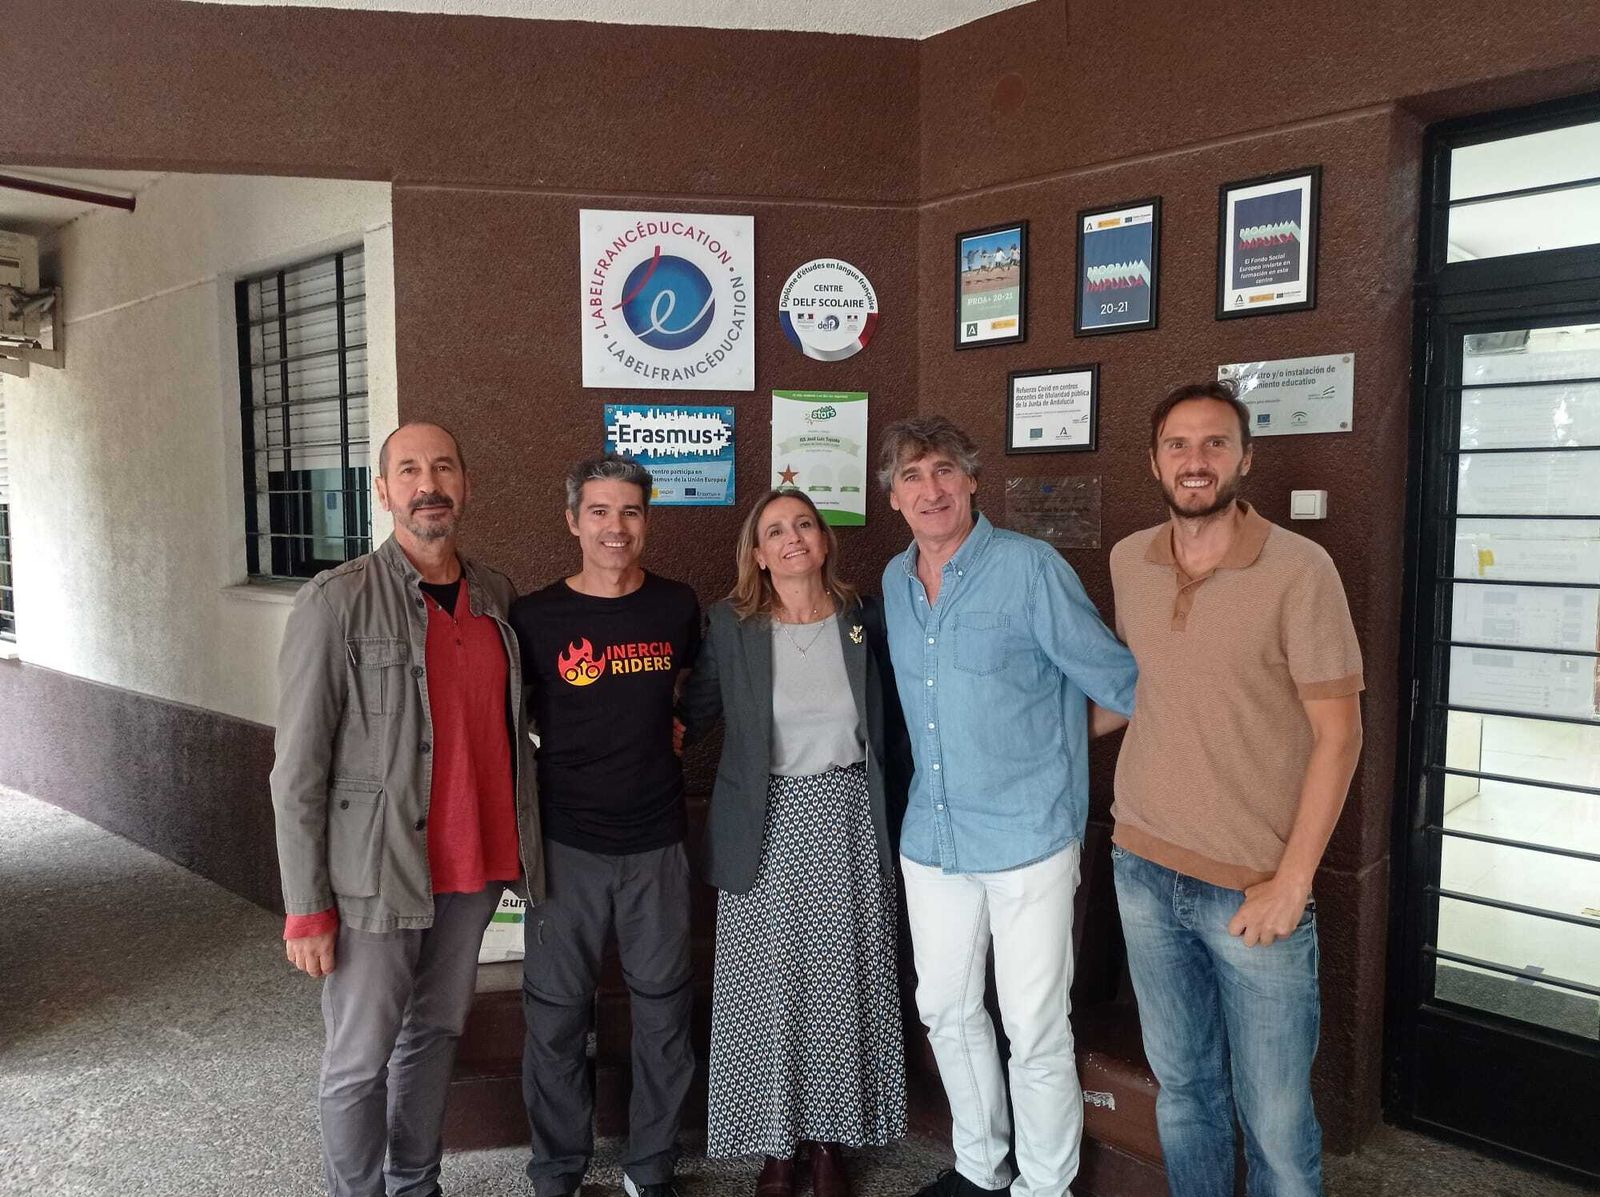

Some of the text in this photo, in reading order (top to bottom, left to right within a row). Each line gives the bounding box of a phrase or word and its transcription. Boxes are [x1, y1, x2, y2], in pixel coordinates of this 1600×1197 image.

[1268, 253, 1286, 261] Social
[590, 221, 732, 329] LABELFRANCÉDUCATION
[781, 277, 799, 308] Diplôme
[796, 262, 825, 280] d'études
[836, 262, 860, 281] langue
[858, 277, 875, 311] française
[813, 284, 844, 292] CENTRE
[792, 297, 864, 308] DELF SCOLAIRE
[1100, 301, 1128, 315] 20-21
[607, 276, 746, 381] LABELFRANCÉDUCATION
[1272, 370, 1284, 379] y/o
[1285, 366, 1325, 377] instalación
[1326, 365, 1336, 373] de
[1038, 384, 1051, 392] Covid
[1281, 378, 1317, 387] educativo
[618, 424, 725, 444] Erasmus+
[606, 642, 673, 660] INERCIA
[611, 656, 671, 675] RIDERS
